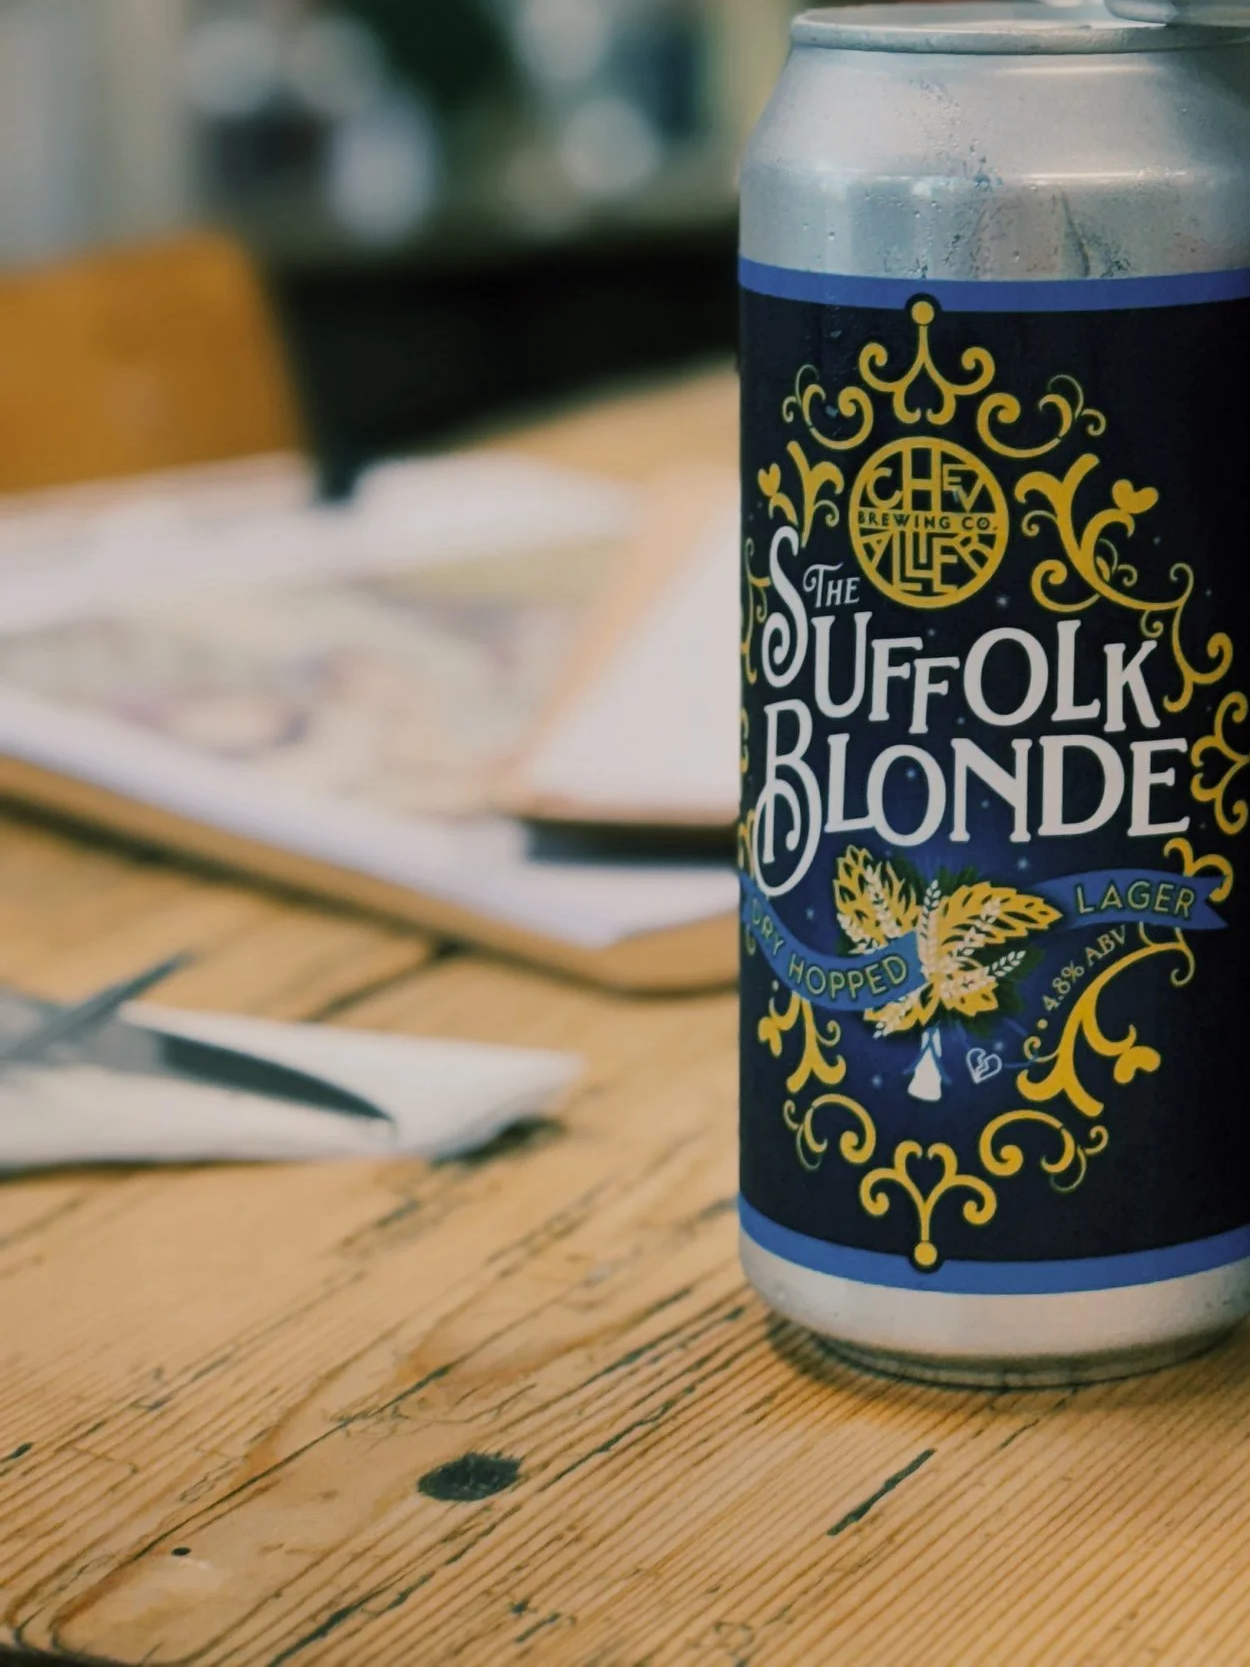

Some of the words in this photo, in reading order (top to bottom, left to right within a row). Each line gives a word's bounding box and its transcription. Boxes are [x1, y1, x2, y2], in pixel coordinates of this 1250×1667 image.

[858, 511, 952, 530] BREWING
[961, 516, 998, 531] CO.
[761, 525, 1161, 734] SUFFOLK
[803, 562, 861, 609] THE
[753, 698, 1191, 896] BLONDE
[1075, 880, 1196, 918] LAGER
[750, 897, 785, 956] DRY
[788, 953, 908, 1000] HOPPED
[1042, 960, 1085, 1012] 4.8%
[1084, 924, 1127, 968] ABV
